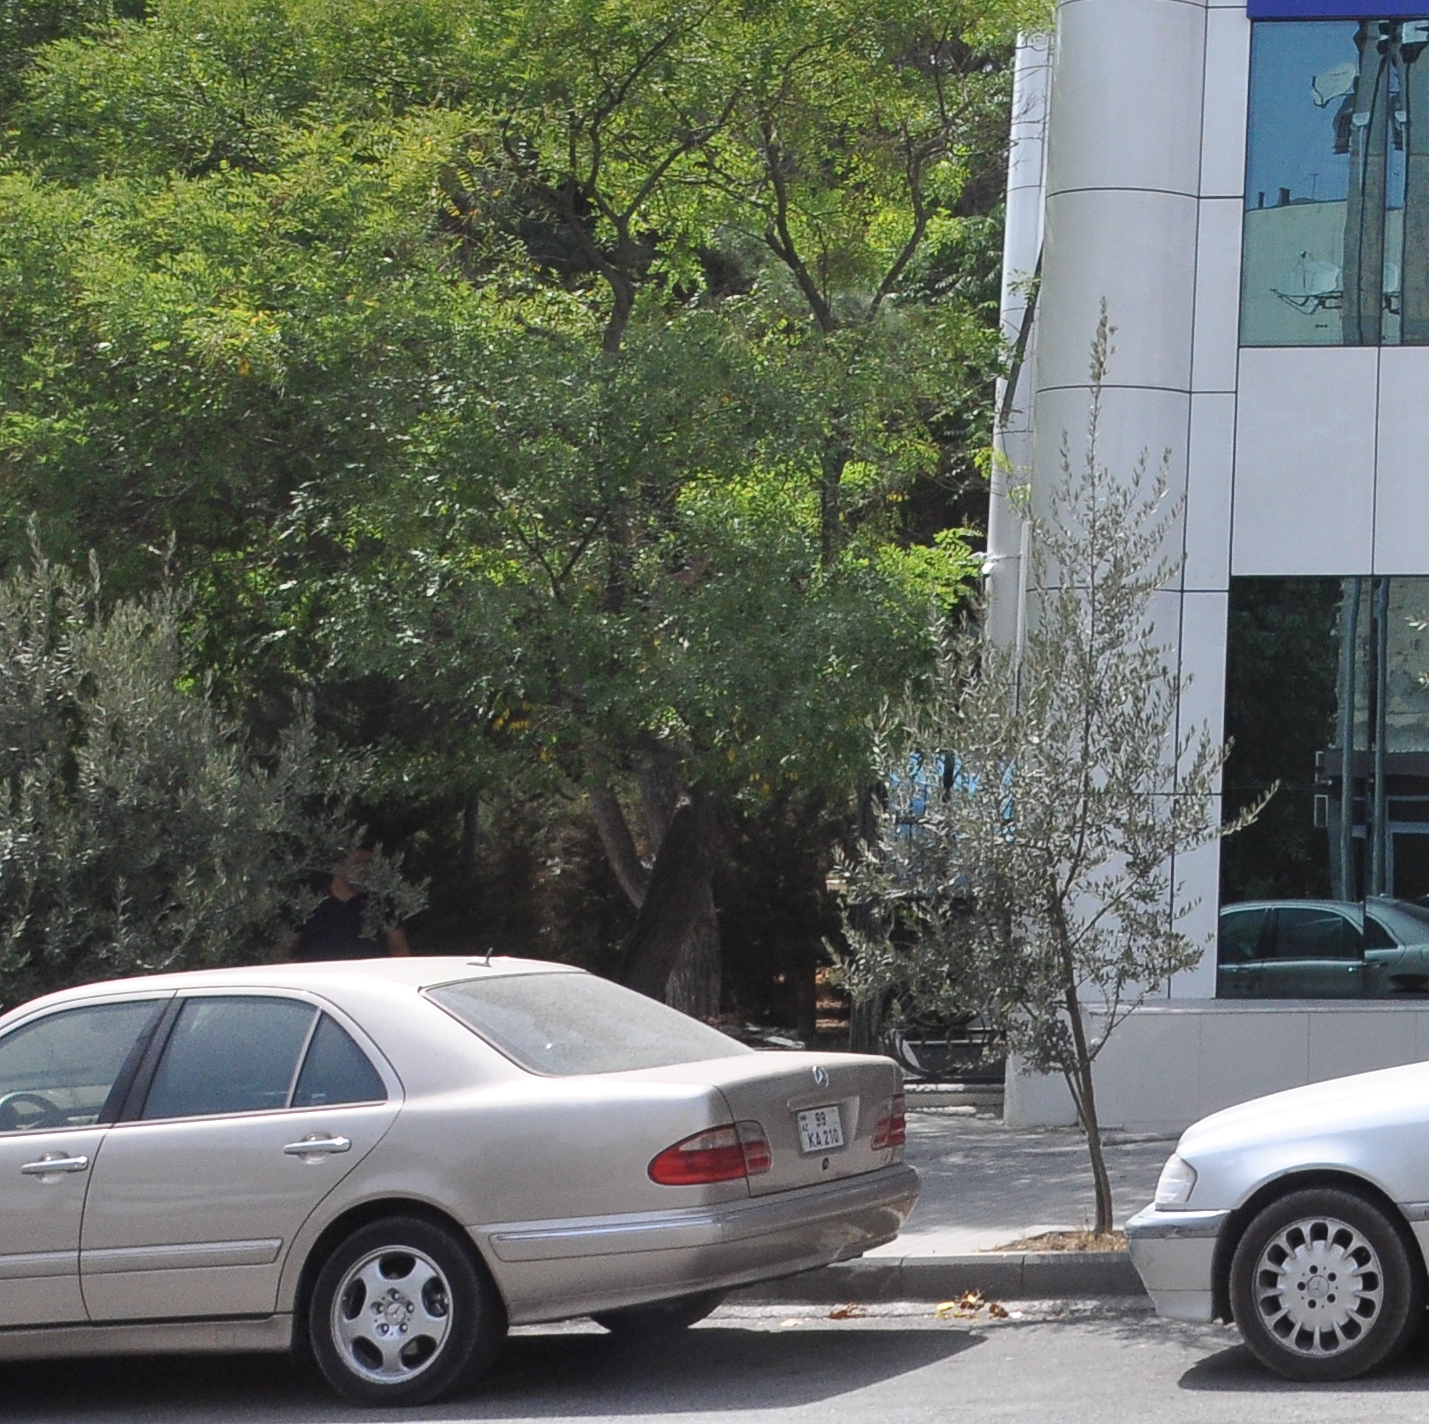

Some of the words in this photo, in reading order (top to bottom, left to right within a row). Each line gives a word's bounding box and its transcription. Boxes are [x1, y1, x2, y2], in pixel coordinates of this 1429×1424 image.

[815, 1111, 826, 1127] 99
[807, 1131, 822, 1148] KA
[823, 1127, 839, 1146] 210
